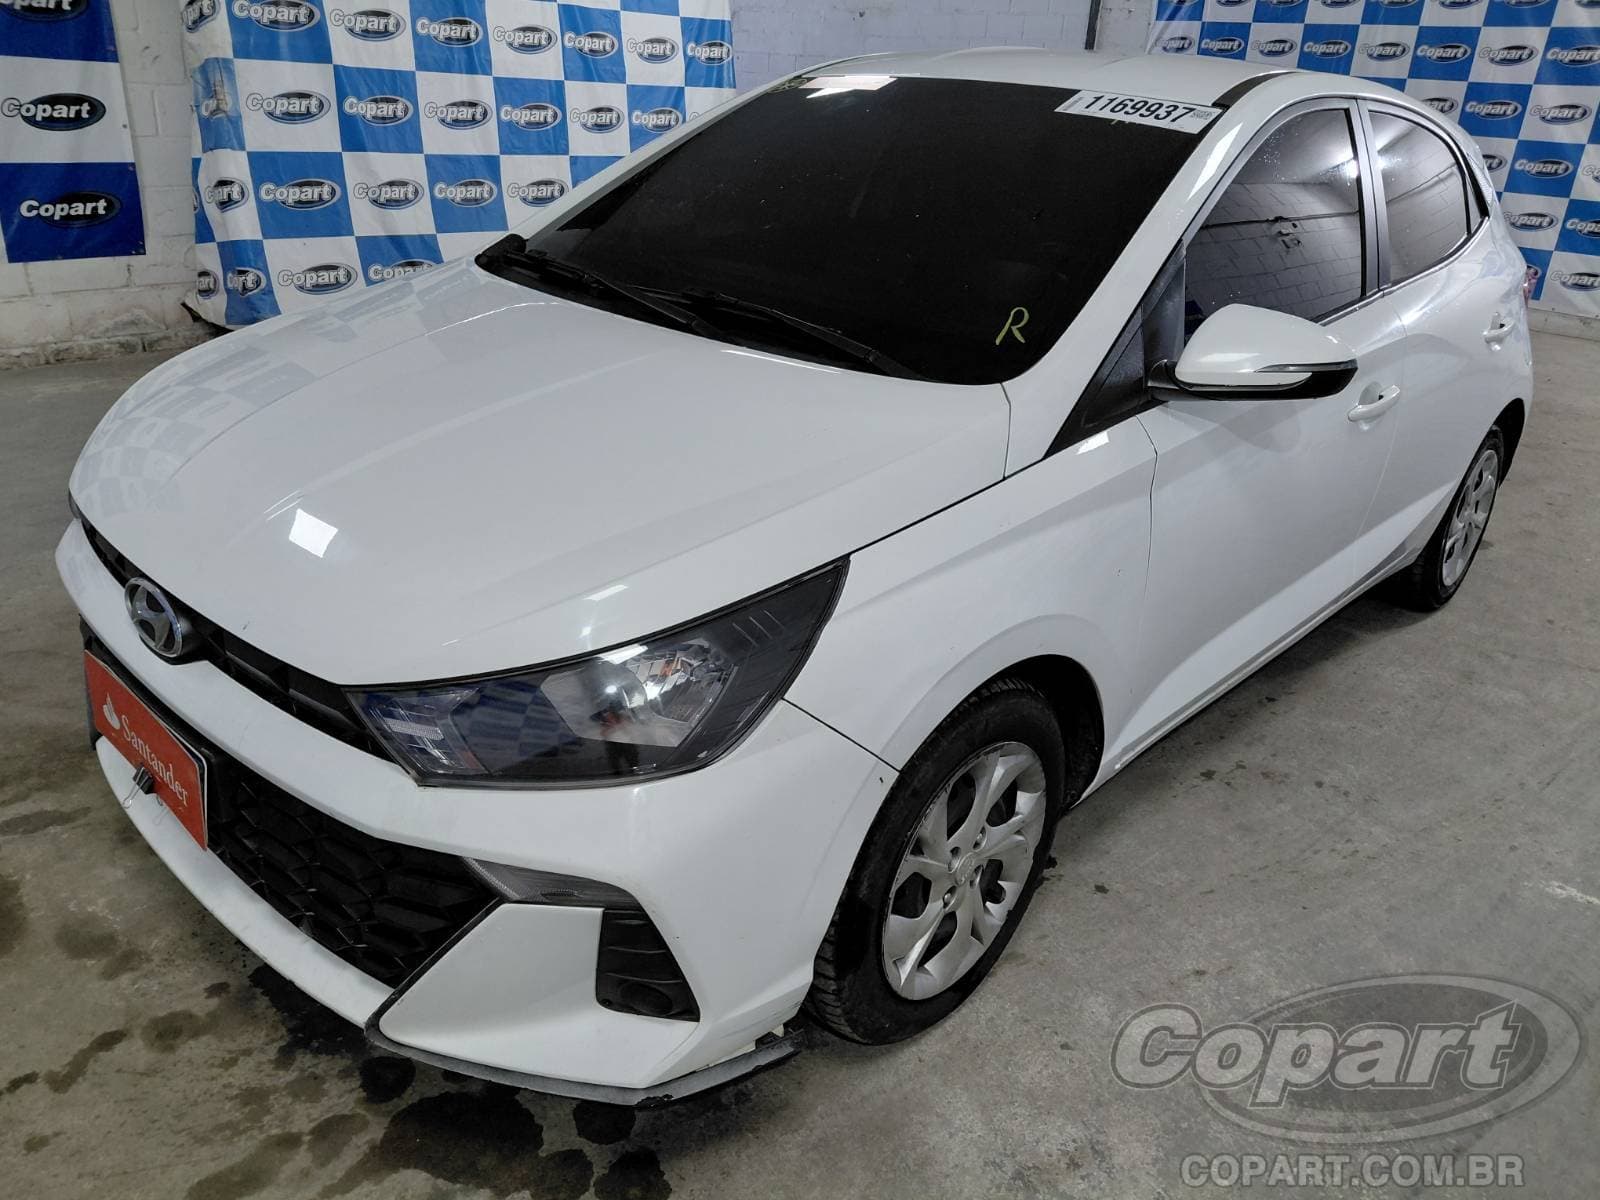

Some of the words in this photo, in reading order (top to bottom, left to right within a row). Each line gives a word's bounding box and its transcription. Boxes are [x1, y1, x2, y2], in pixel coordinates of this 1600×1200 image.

[232, 0, 309, 24] Copart
[331, 9, 397, 33] Copart
[416, 17, 477, 41] Copart
[493, 26, 549, 47] Copart
[563, 31, 612, 53] Copart
[627, 38, 672, 58] Copart
[687, 42, 728, 59] Copart
[1201, 39, 1241, 51] Copart
[1251, 40, 1290, 52] Copart
[1303, 42, 1346, 54] Copart
[1359, 43, 1402, 57] Copart
[1417, 45, 1465, 60] Copart
[1480, 46, 1530, 60] Copart
[1, 98, 90, 121] Copart
[246, 92, 320, 115] Copart
[343, 97, 405, 118] Copart
[424, 101, 485, 124] Copart
[1085, 95, 1197, 122] 1169937
[1465, 102, 1514, 115] Copart
[1530, 104, 1584, 119] Copart
[501, 105, 555, 126] Copart
[570, 108, 618, 127] Copart
[632, 110, 677, 128] Copart
[1514, 159, 1565, 173] Copart
[260, 182, 332, 205] Copart
[354, 182, 416, 203] Copart
[434, 182, 490, 202] Copart
[507, 182, 561, 201] Copart
[20, 199, 107, 220] Copart
[278, 266, 347, 289] Copart
[995, 306, 1030, 346] R
[121, 714, 188, 808] Santander
